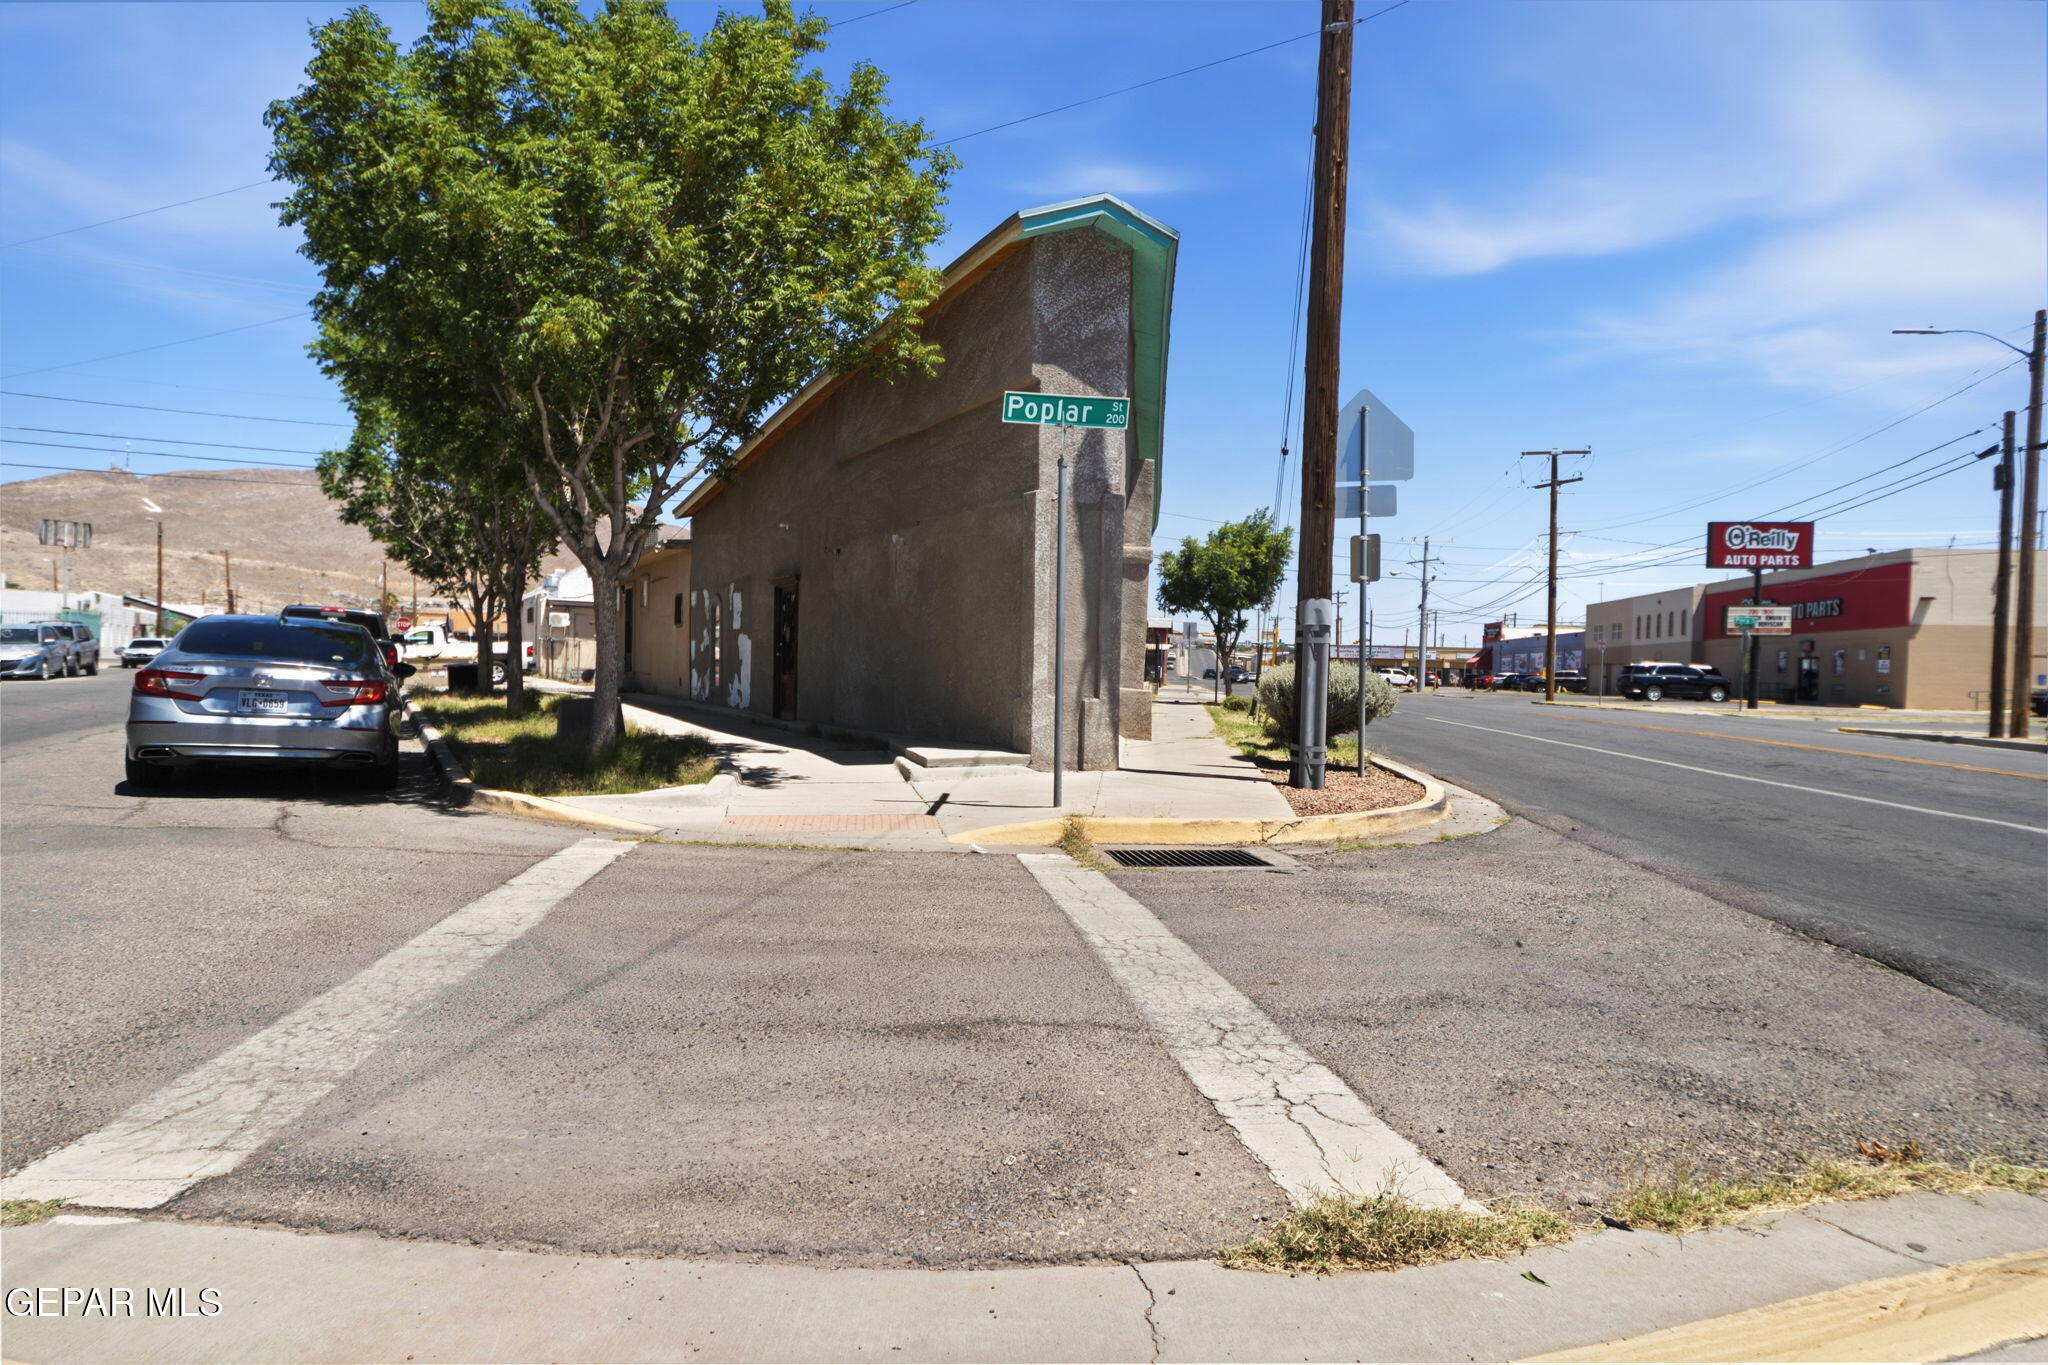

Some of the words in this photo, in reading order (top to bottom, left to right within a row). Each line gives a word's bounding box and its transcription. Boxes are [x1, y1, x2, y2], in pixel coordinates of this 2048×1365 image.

[1007, 396, 1093, 423] Poplar
[1112, 402, 1123, 412] St
[1105, 413, 1125, 424] 200
[1726, 526, 1799, 550] O'Reilly
[1724, 554, 1757, 566] AUTO
[1760, 554, 1800, 566] PARTS
[1806, 600, 1840, 617] PARTS
